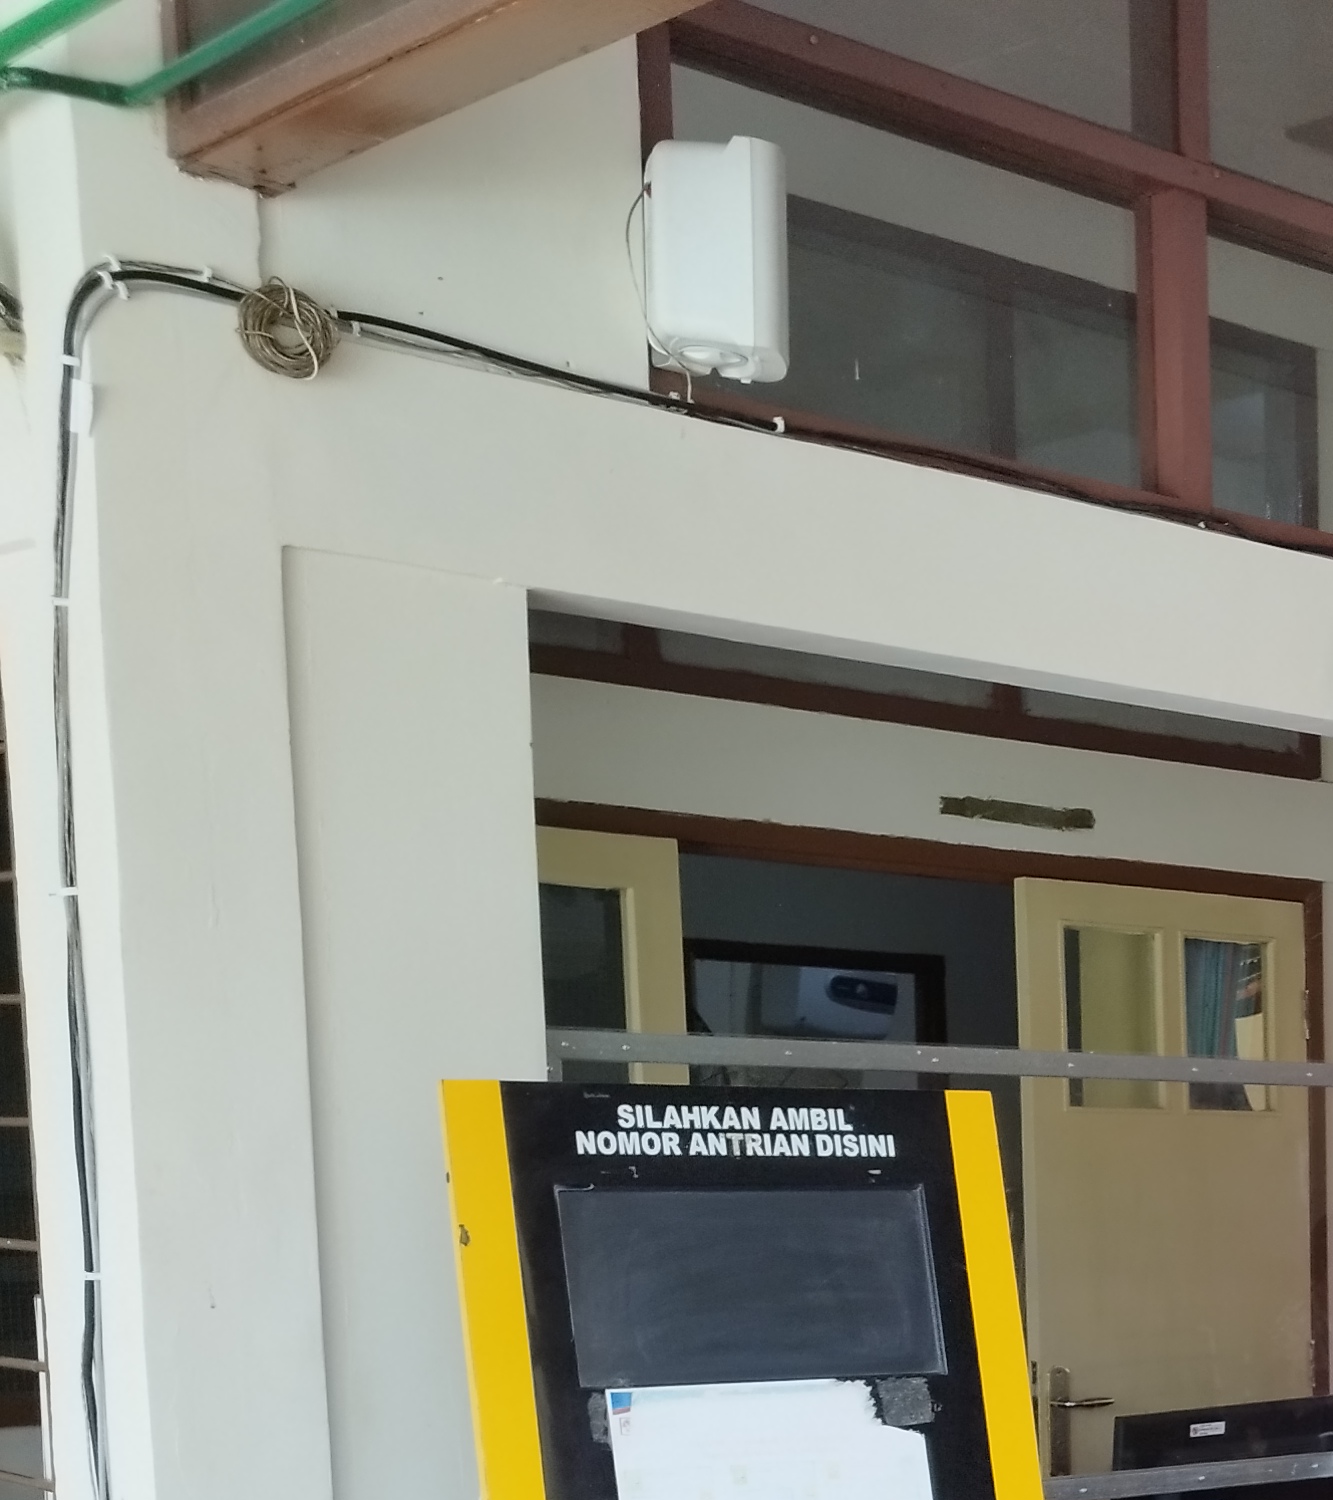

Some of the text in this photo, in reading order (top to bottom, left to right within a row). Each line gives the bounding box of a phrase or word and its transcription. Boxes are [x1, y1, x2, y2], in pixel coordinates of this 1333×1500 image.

[617, 1104, 853, 1131] SILAHKAN AMBIL
[575, 1131, 896, 1157] NOMOR ANTRIAN DISINI
